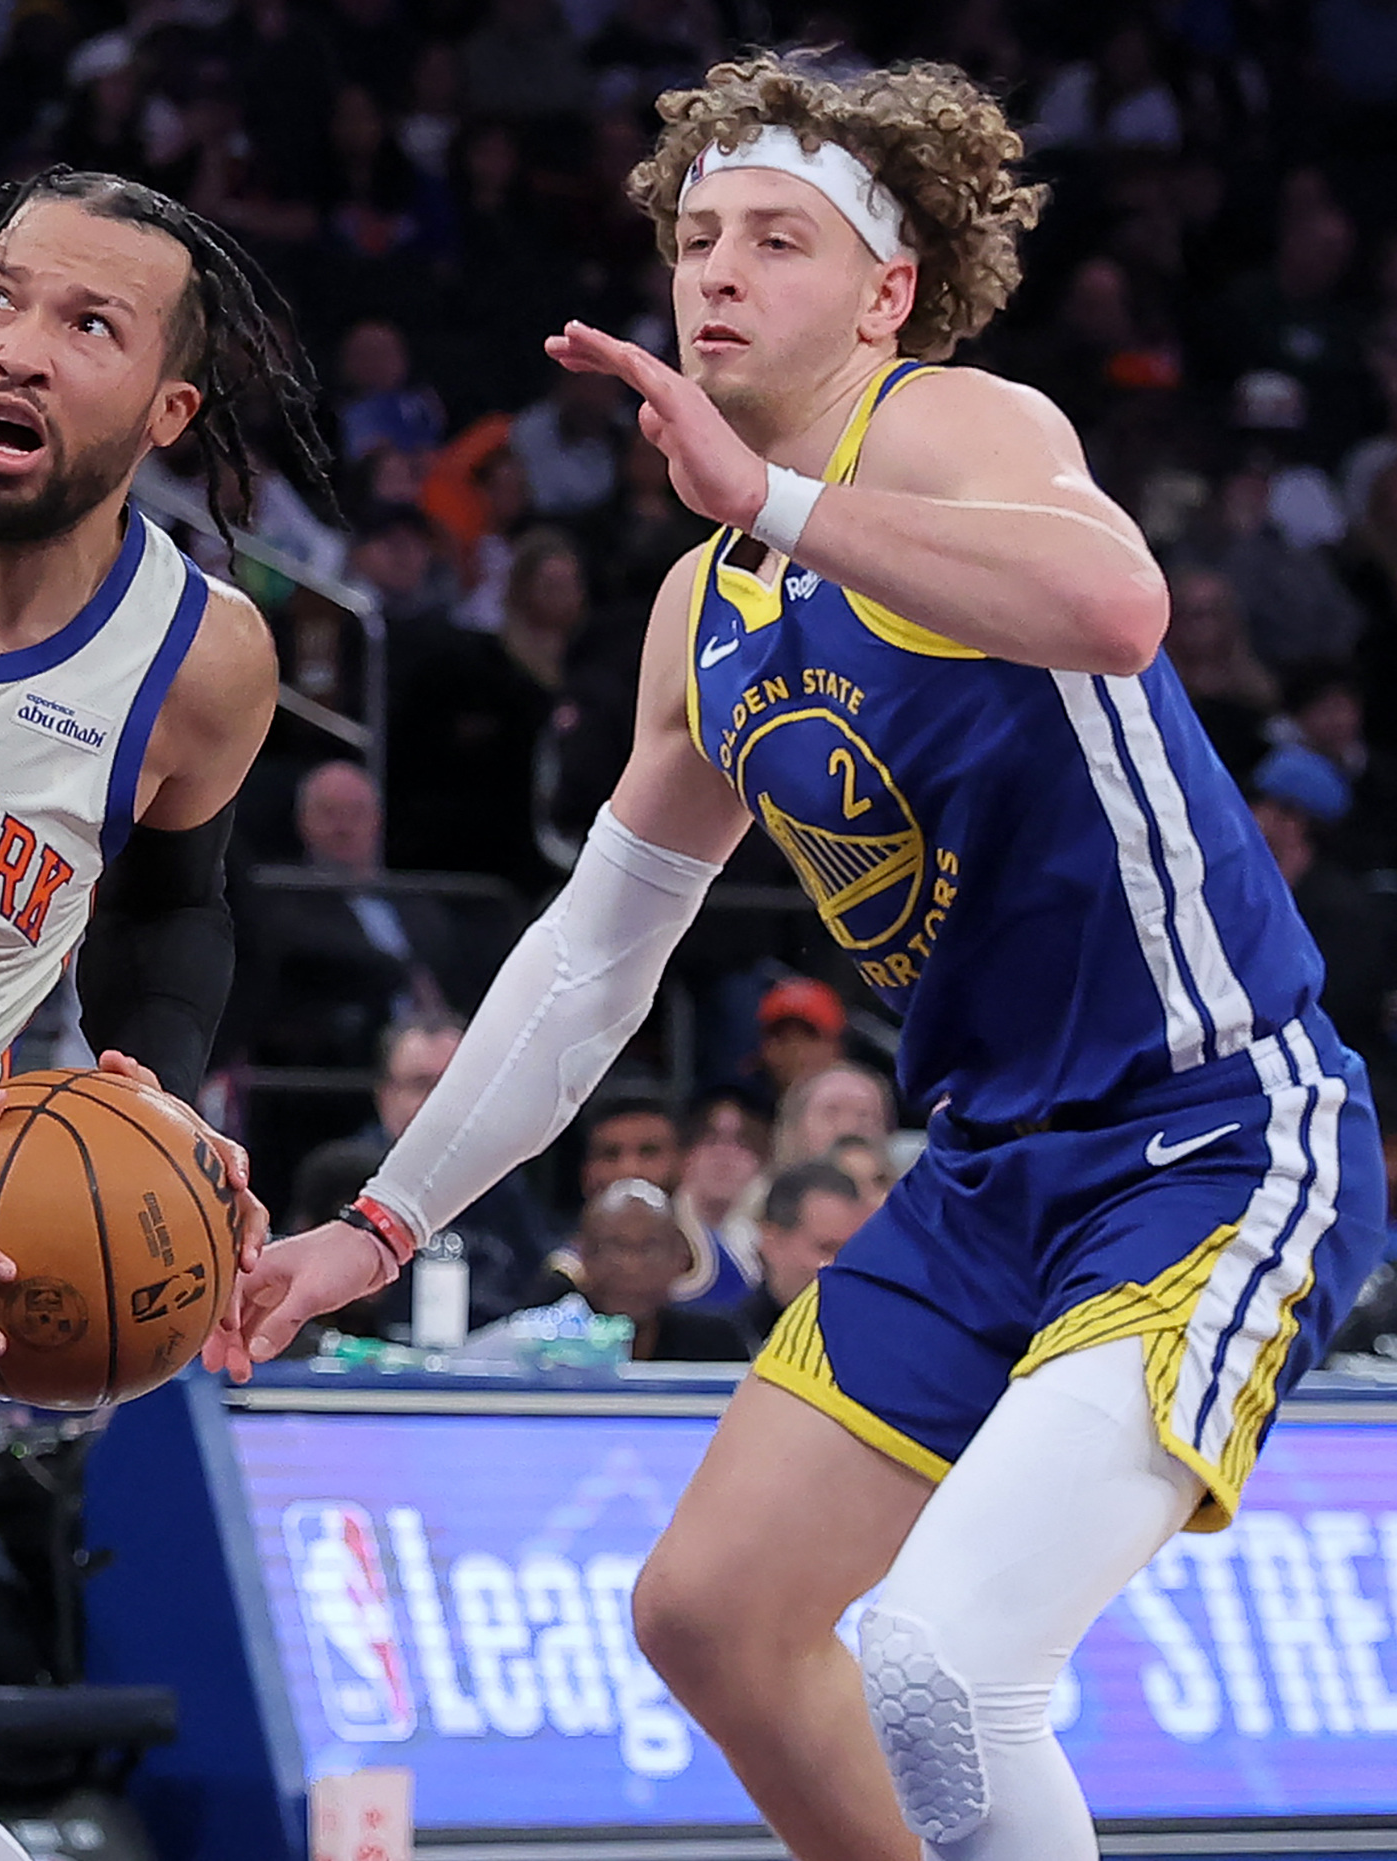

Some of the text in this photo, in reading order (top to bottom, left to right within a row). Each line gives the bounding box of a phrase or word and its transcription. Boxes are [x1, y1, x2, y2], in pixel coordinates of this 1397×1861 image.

[26, 693, 76, 717] experience
[802, 668, 865, 715] STATE
[17, 705, 108, 748] abu dhabi
[828, 747, 872, 820] 2
[386, 1504, 1397, 1780] Leag STRE
